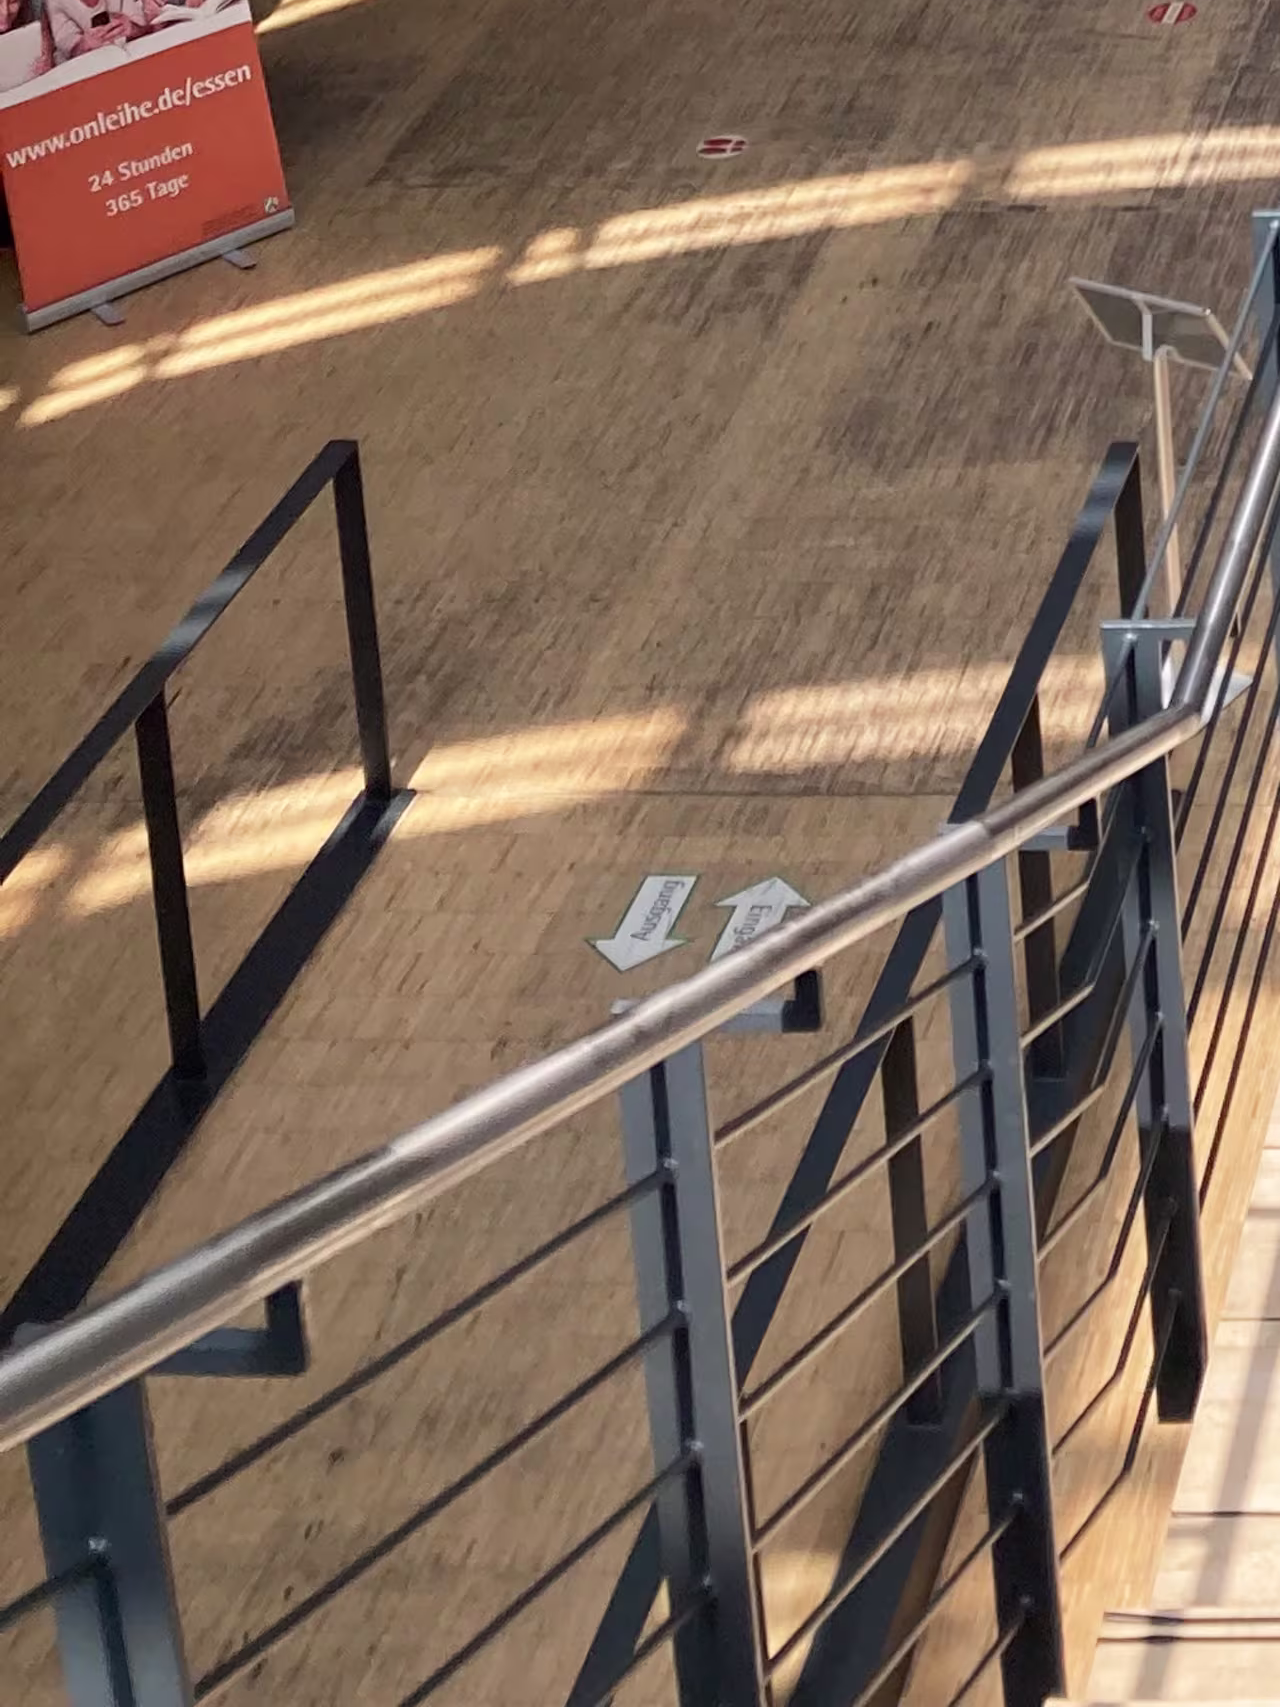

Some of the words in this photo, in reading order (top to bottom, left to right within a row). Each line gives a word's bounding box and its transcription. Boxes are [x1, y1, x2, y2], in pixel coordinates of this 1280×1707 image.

[5, 64, 252, 169] www.onleihe.de/essen
[88, 171, 115, 193] 24
[118, 140, 194, 181] Stunden
[105, 190, 143, 218] 365
[146, 173, 190, 200] Tage
[630, 880, 686, 942] Ausgang
